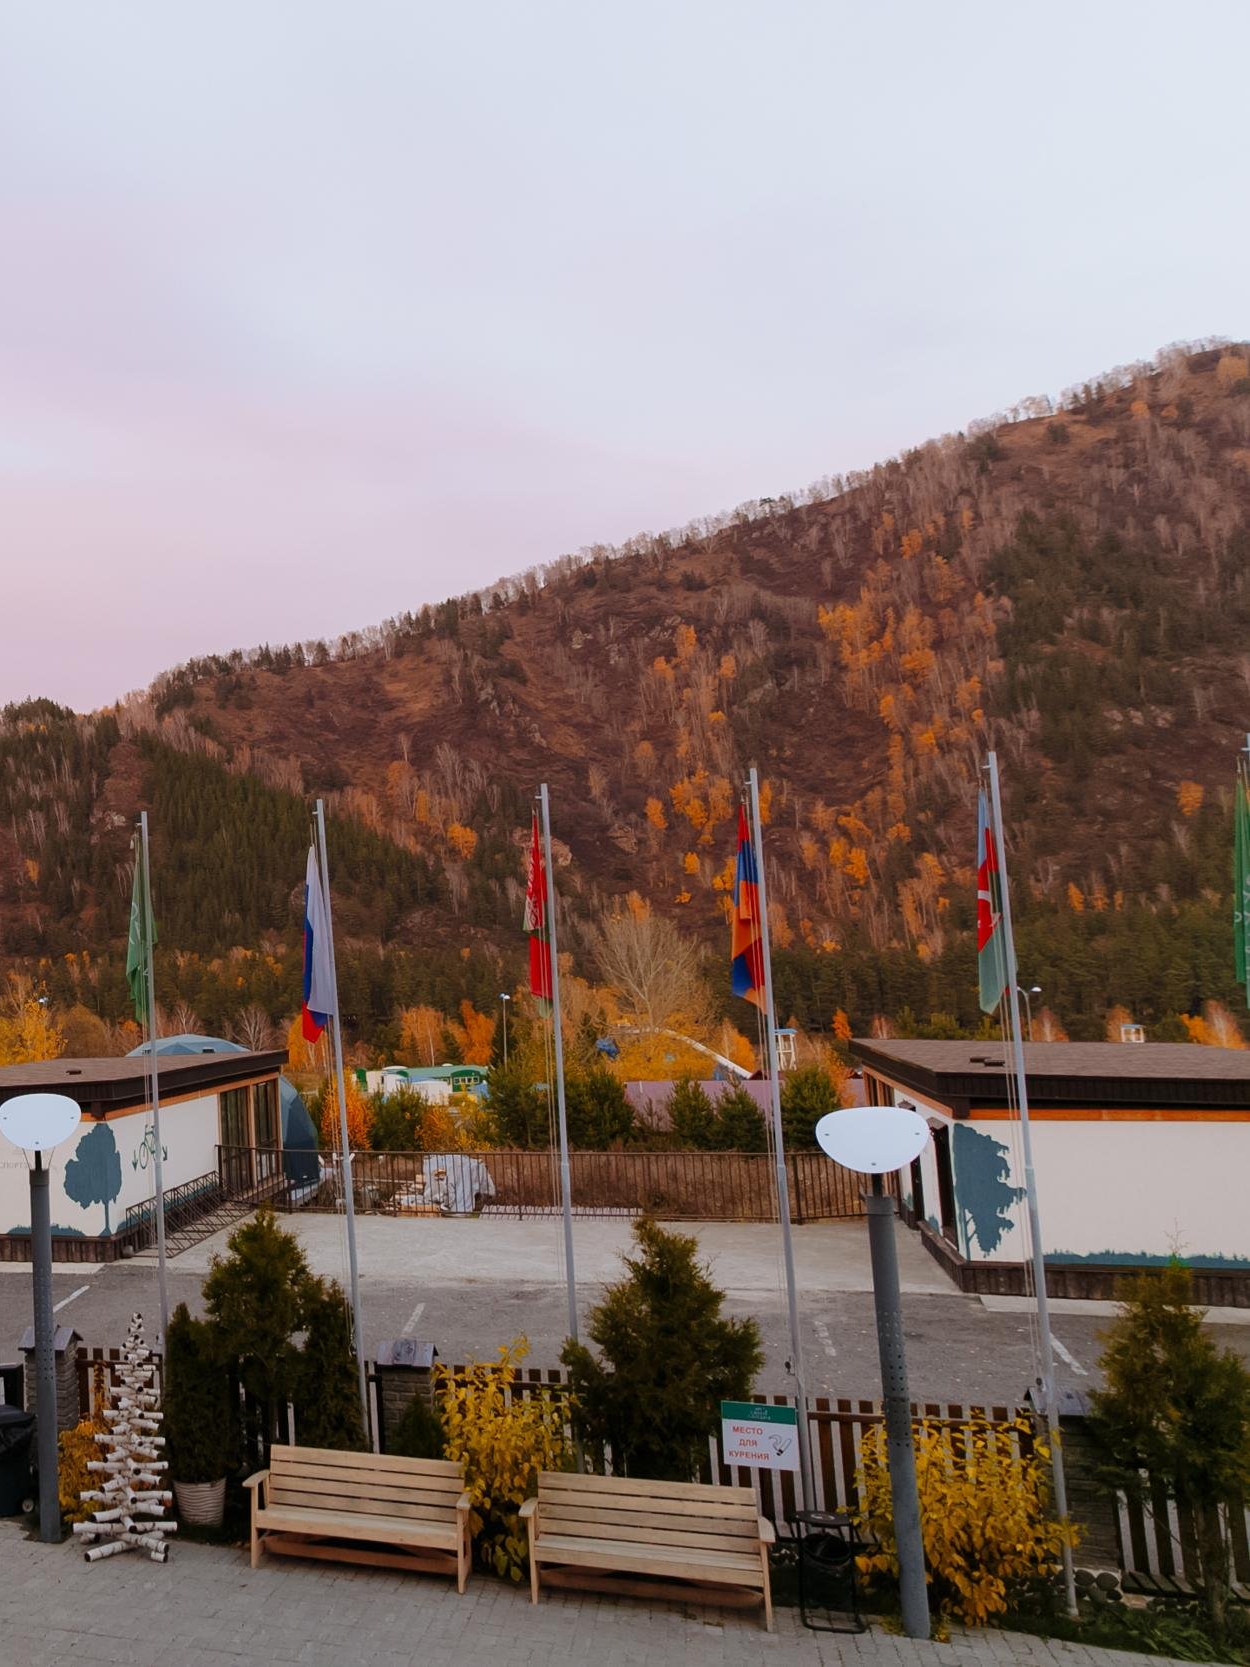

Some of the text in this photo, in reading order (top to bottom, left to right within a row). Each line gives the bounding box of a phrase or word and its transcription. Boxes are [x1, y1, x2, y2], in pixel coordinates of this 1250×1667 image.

[732, 1425, 763, 1435] МЕСТО
[738, 1438, 758, 1447] ДЛЯ
[728, 1450, 770, 1461] КУРЕНИЯ
